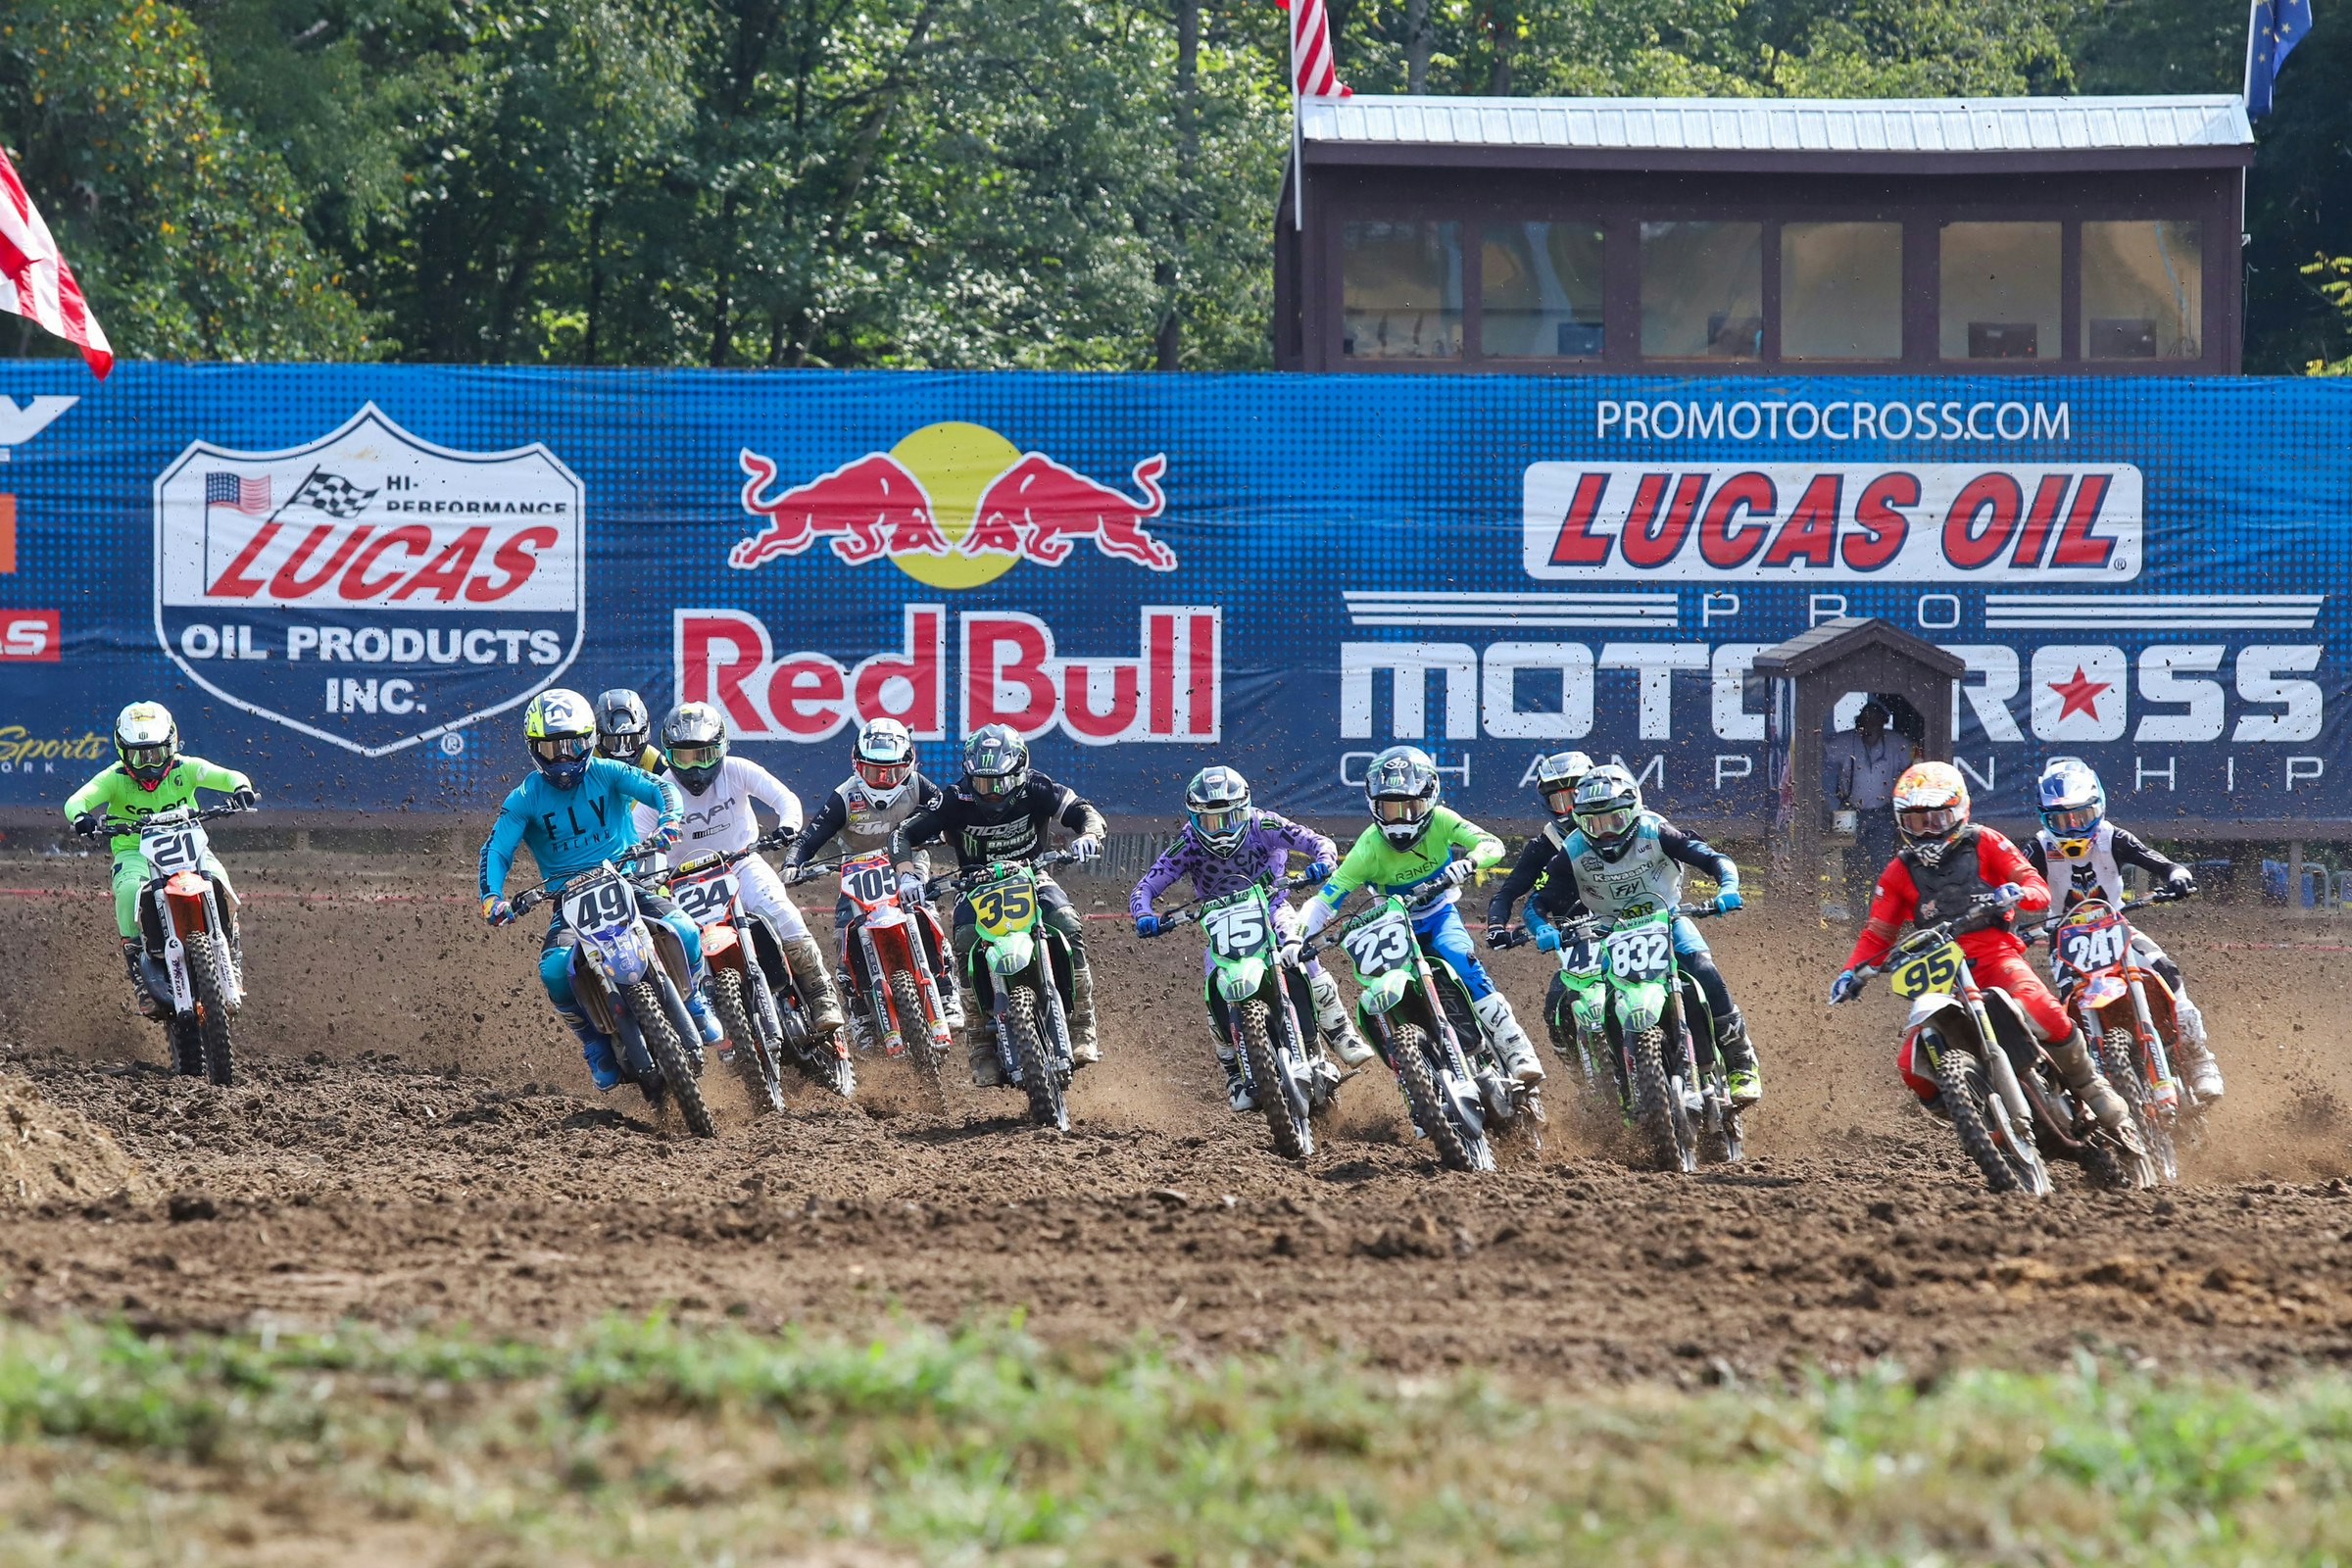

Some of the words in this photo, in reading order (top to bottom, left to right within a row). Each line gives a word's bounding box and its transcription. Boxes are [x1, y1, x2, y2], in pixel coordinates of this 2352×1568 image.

[1596, 400, 2071, 440] PROMOTOCROSS.COM
[386, 475, 419, 491] HI-
[1548, 469, 1922, 572] LUCAS
[1940, 469, 2115, 571] OIL
[205, 521, 560, 602] LUCAS
[1702, 593, 1960, 629] PRO
[180, 624, 269, 661] OIL
[287, 626, 562, 665] PRODUCTS
[678, 606, 941, 741] Red
[964, 606, 1219, 742] Bull
[1340, 642, 2324, 743] MOTOROSS
[325, 678, 426, 714] INC.
[541, 795, 607, 841] FLY
[847, 821, 891, 835] KTM
[964, 814, 1031, 837] MOOSE
[153, 833, 197, 867] 21
[551, 829, 611, 853] RACING
[848, 867, 900, 901] 105
[1592, 860, 1653, 882] Kawasaki
[1616, 880, 1640, 896] FLY
[576, 883, 630, 931] 49
[678, 878, 733, 918] 24
[980, 885, 1031, 929] 35
[1209, 915, 1264, 955] 15
[1353, 922, 1410, 975] 23
[2068, 924, 2126, 973] 241
[219, 950, 234, 988] DUNLOP
[1611, 934, 1669, 978] 832
[1904, 948, 1954, 999] 95
[756, 982, 775, 1024] DUNLOP
[877, 991, 891, 1031] DUNLOP
[1051, 1000, 1067, 1052] DUNLOP
[1283, 1015, 1301, 1063] DUNLOP
[1444, 1036, 1466, 1083] DUNLOP
